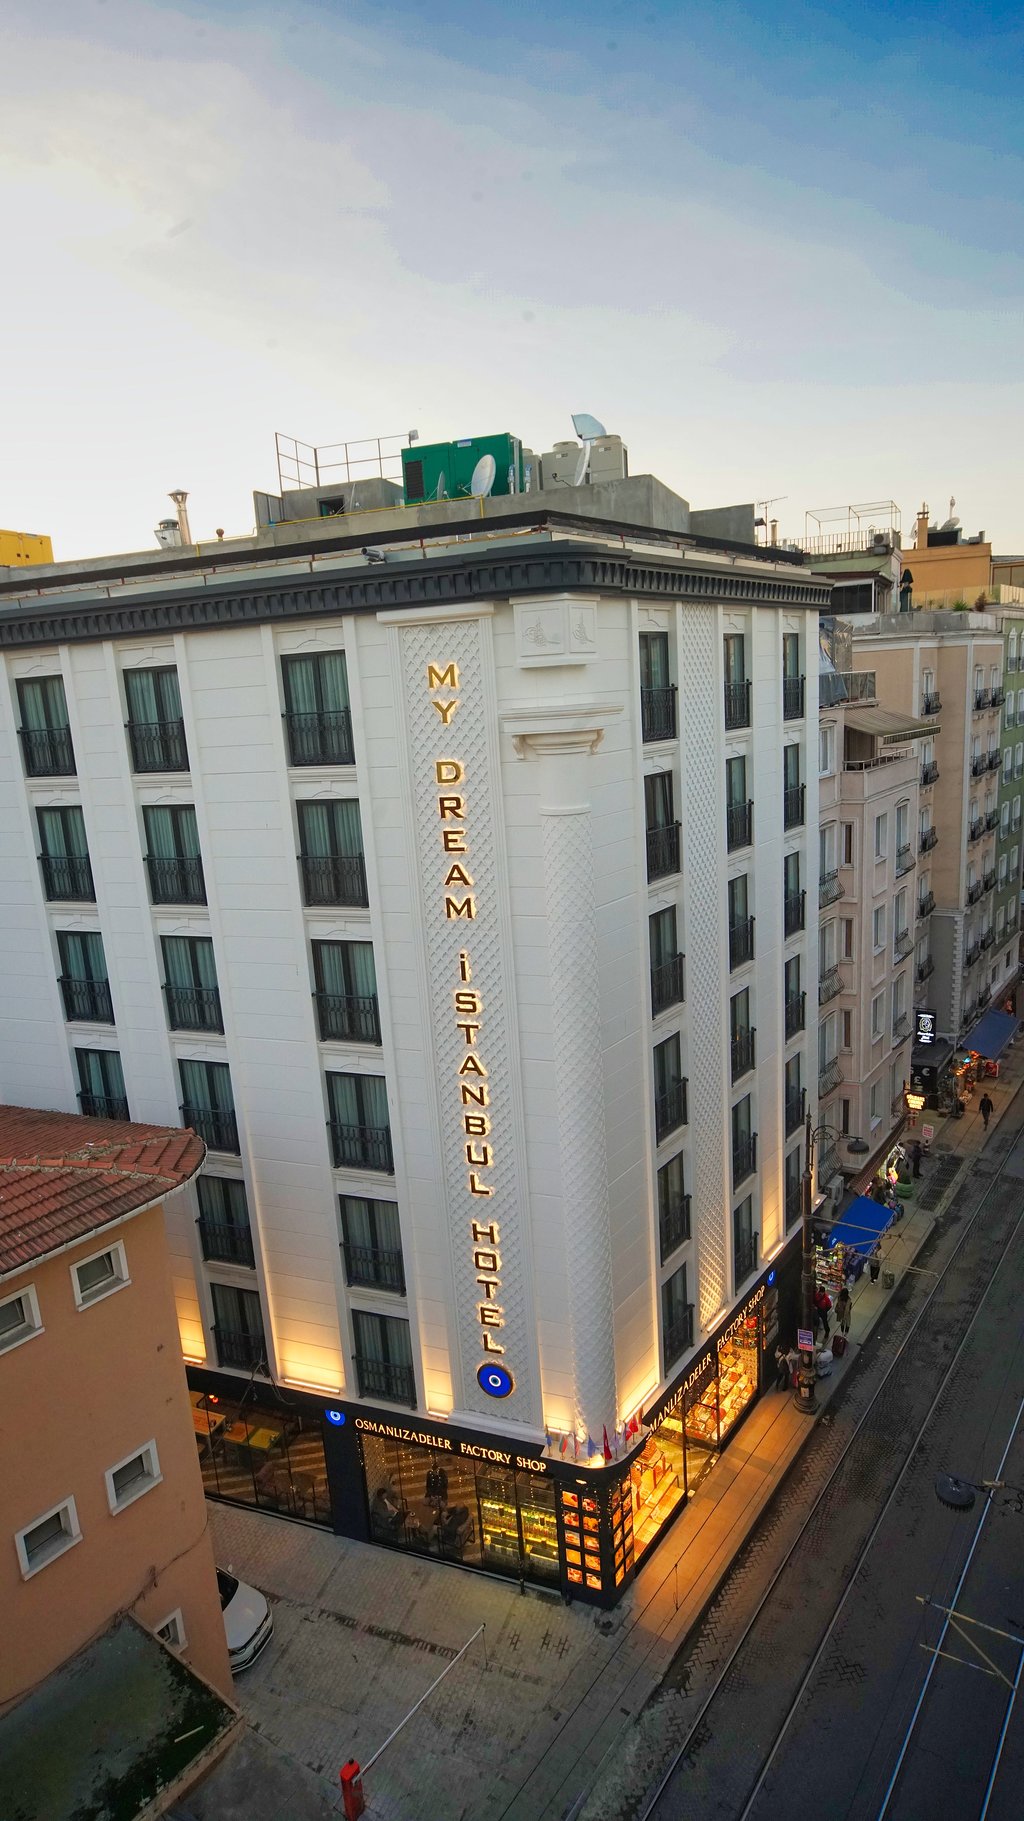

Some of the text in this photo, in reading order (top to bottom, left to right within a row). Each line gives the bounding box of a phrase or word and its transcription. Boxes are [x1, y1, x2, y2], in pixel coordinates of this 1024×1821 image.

[427, 663, 457, 724] MY
[435, 761, 473, 919] DREAM
[472, 1213, 503, 1354] HOTEL
[717, 1308, 748, 1352] FACTORY
[748, 1285, 765, 1313] SHOP
[355, 1418, 547, 1473] OSMANLIZADELER FACTORY SHOP
